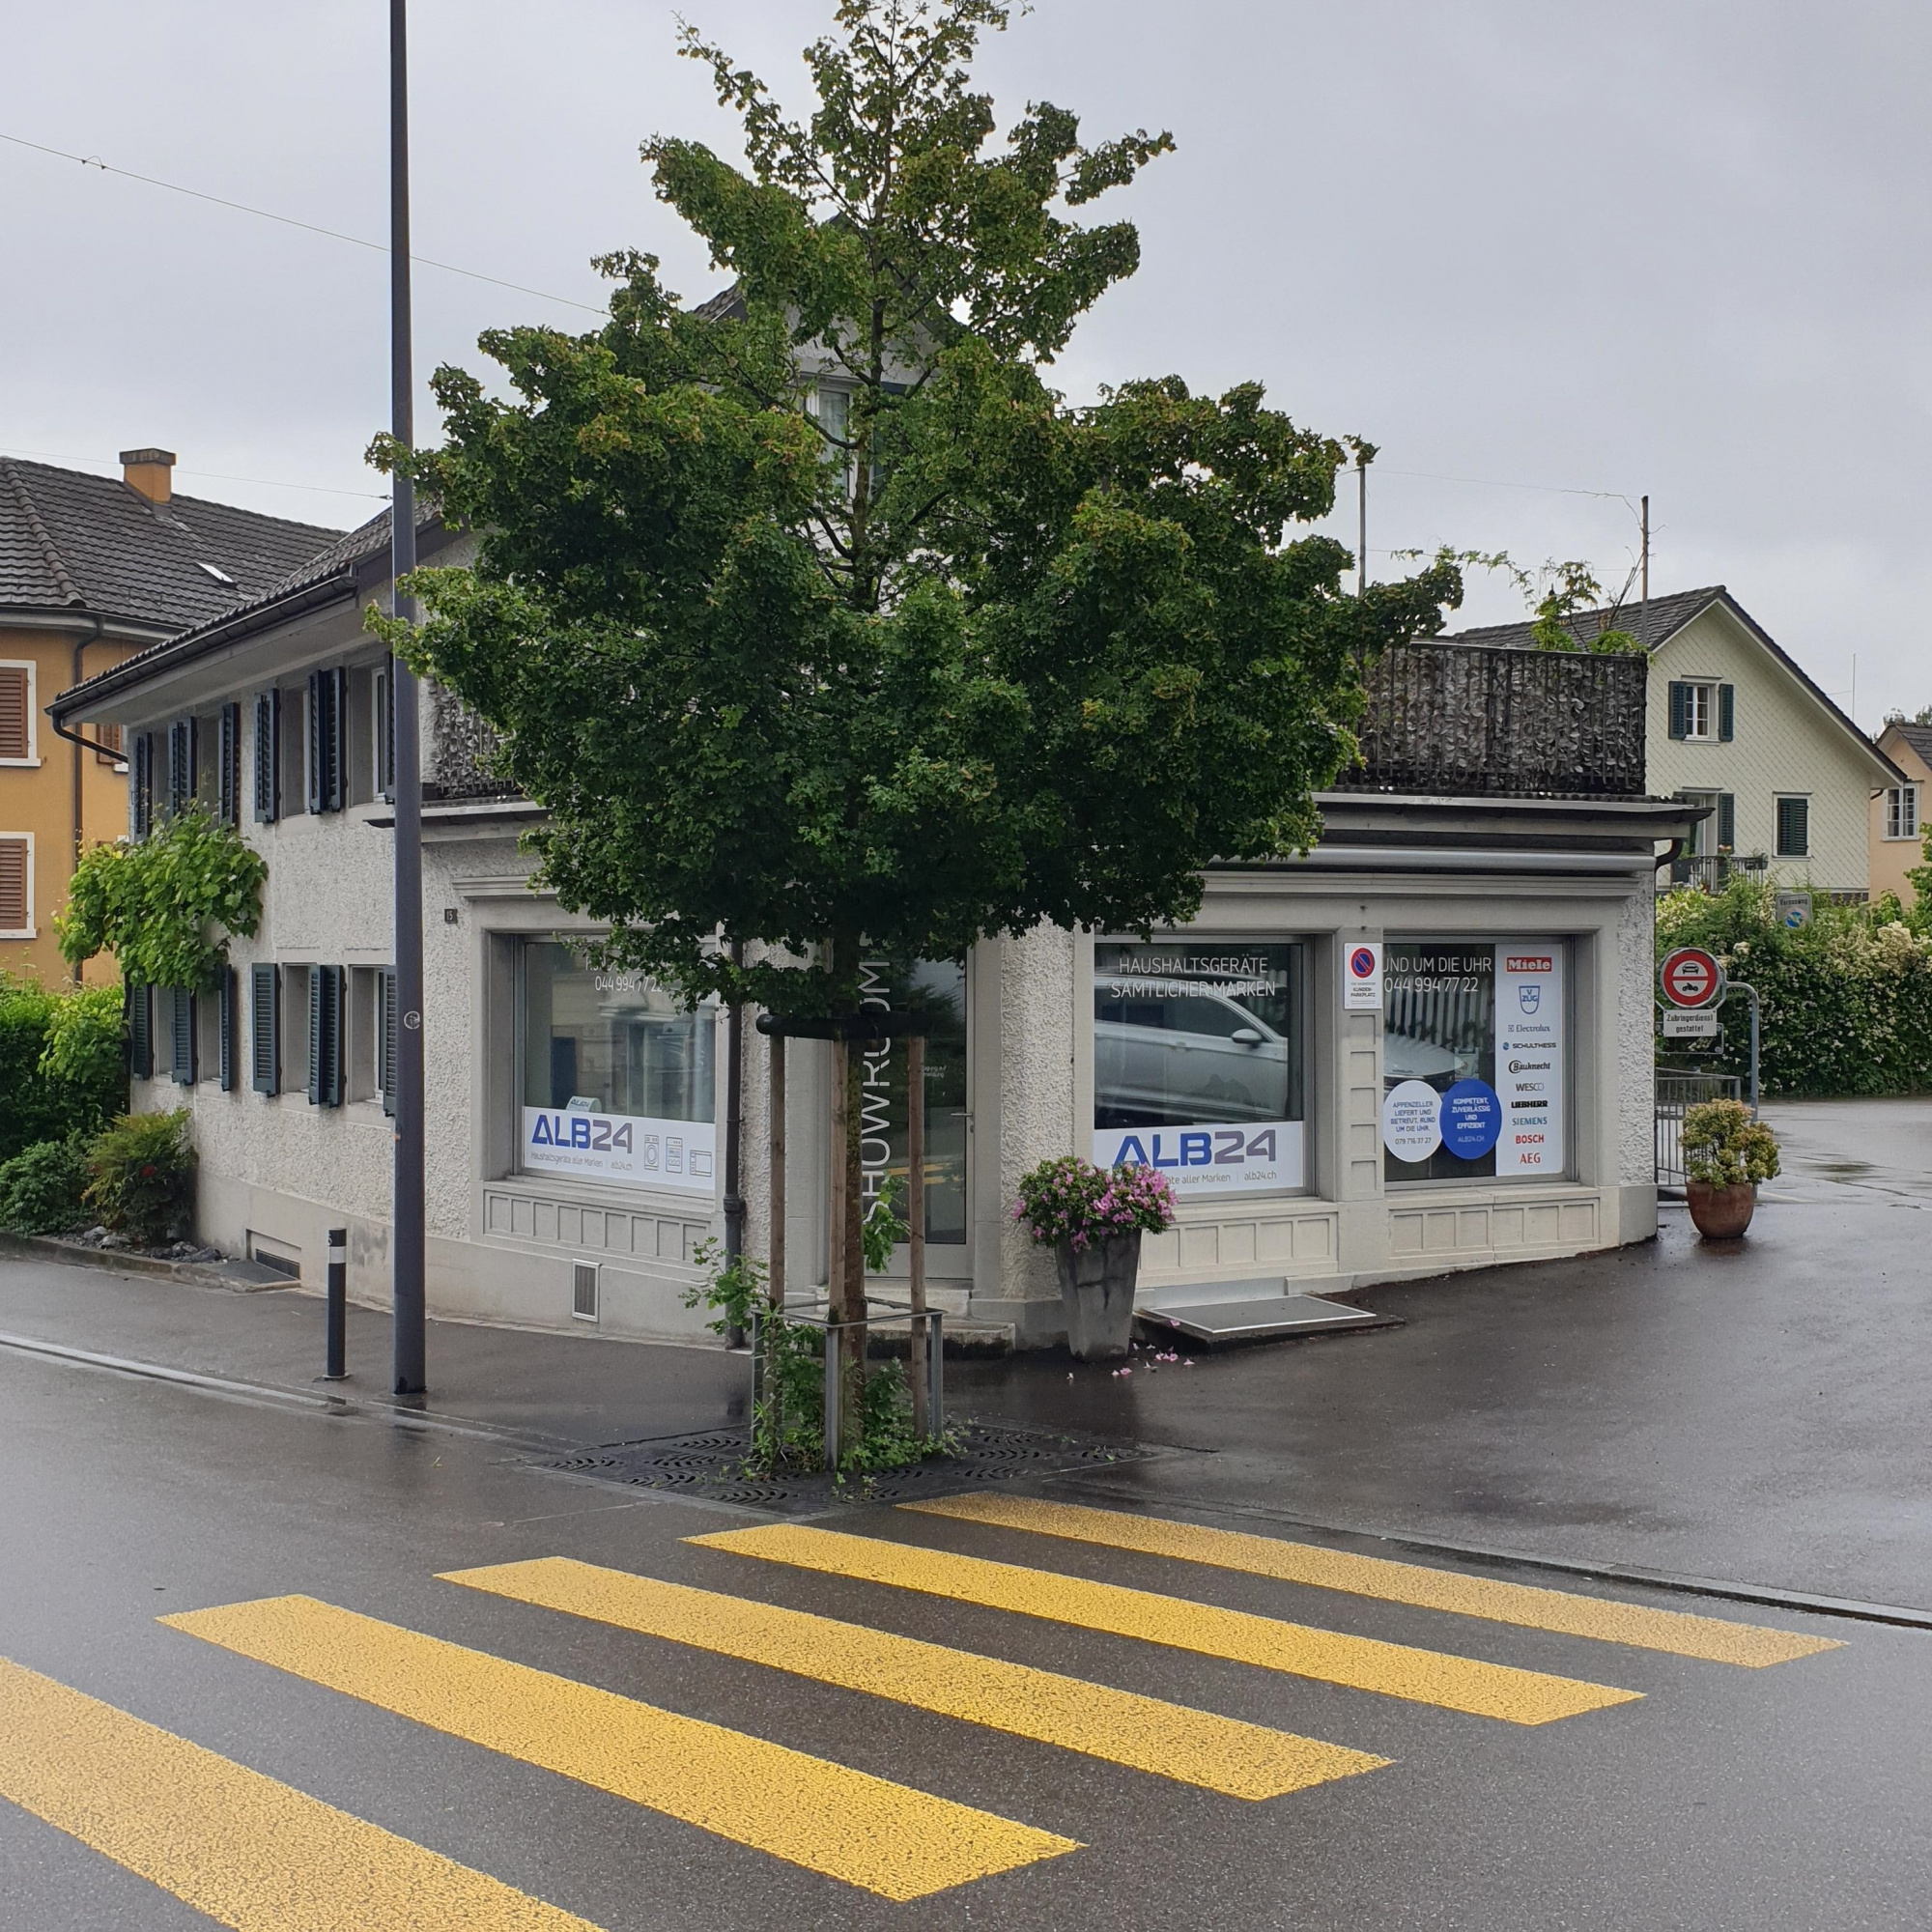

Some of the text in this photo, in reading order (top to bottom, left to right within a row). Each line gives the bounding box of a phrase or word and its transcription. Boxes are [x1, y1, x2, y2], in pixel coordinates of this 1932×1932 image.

[1119, 953, 1268, 974] HAUSHALTSGERÄTE
[1413, 956, 1435, 973] UM
[1438, 956, 1460, 973] DIE
[1463, 956, 1492, 973] UHR
[1508, 959, 1551, 971] Miele
[595, 976, 613, 991] 044
[1212, 980, 1276, 997] MARKEN
[1383, 977, 1479, 993] 044 994 77 22
[1666, 1014, 1714, 1023] Zubringerdienst
[1517, 1024, 1550, 1033] Electrolux
[1676, 1025, 1704, 1034] gestattet
[1511, 1061, 1550, 1072] Bauknecht
[1516, 1083, 1545, 1092] WESCO
[1511, 1100, 1548, 1109] LIEBHERR
[1512, 1117, 1548, 1126] SIEMENS
[531, 1114, 633, 1154] ALB24
[1515, 1134, 1545, 1144] BOSCH
[1112, 1129, 1276, 1168] ALB24
[1520, 1152, 1541, 1165] AEG
[1181, 1174, 1200, 1184] aller
[1202, 1173, 1232, 1183] Marken
[1244, 1170, 1277, 1181] alb24.ch
